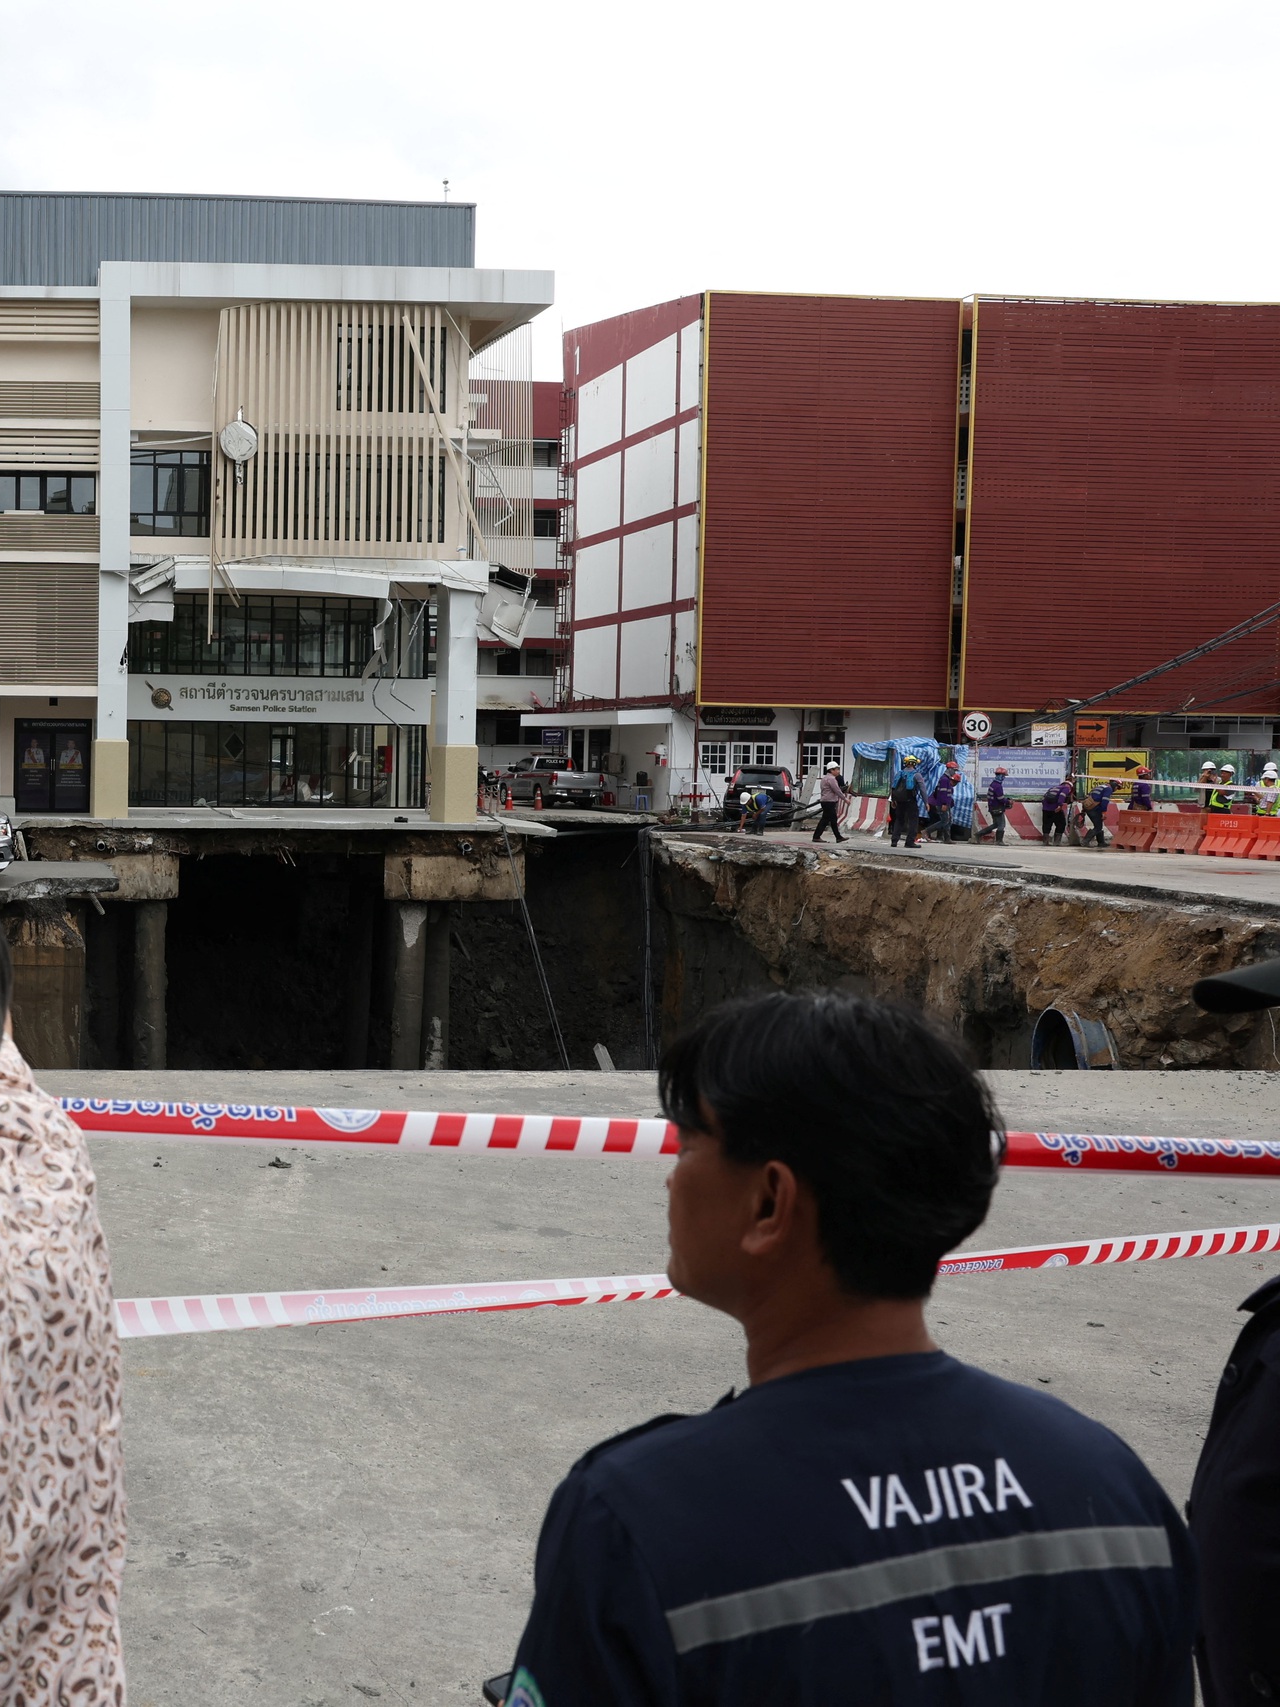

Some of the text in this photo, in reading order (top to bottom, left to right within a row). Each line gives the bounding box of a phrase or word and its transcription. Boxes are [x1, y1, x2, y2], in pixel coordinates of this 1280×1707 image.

[179, 682, 365, 702] สถานีตำรวจนครบาลสามเสน
[229, 704, 317, 713] Samsen Police Station
[966, 719, 988, 732] 30
[938, 1258, 1004, 1275] DANGEROUS
[840, 1457, 1034, 1531] VAJIRA
[911, 1602, 1013, 1674] EMT
